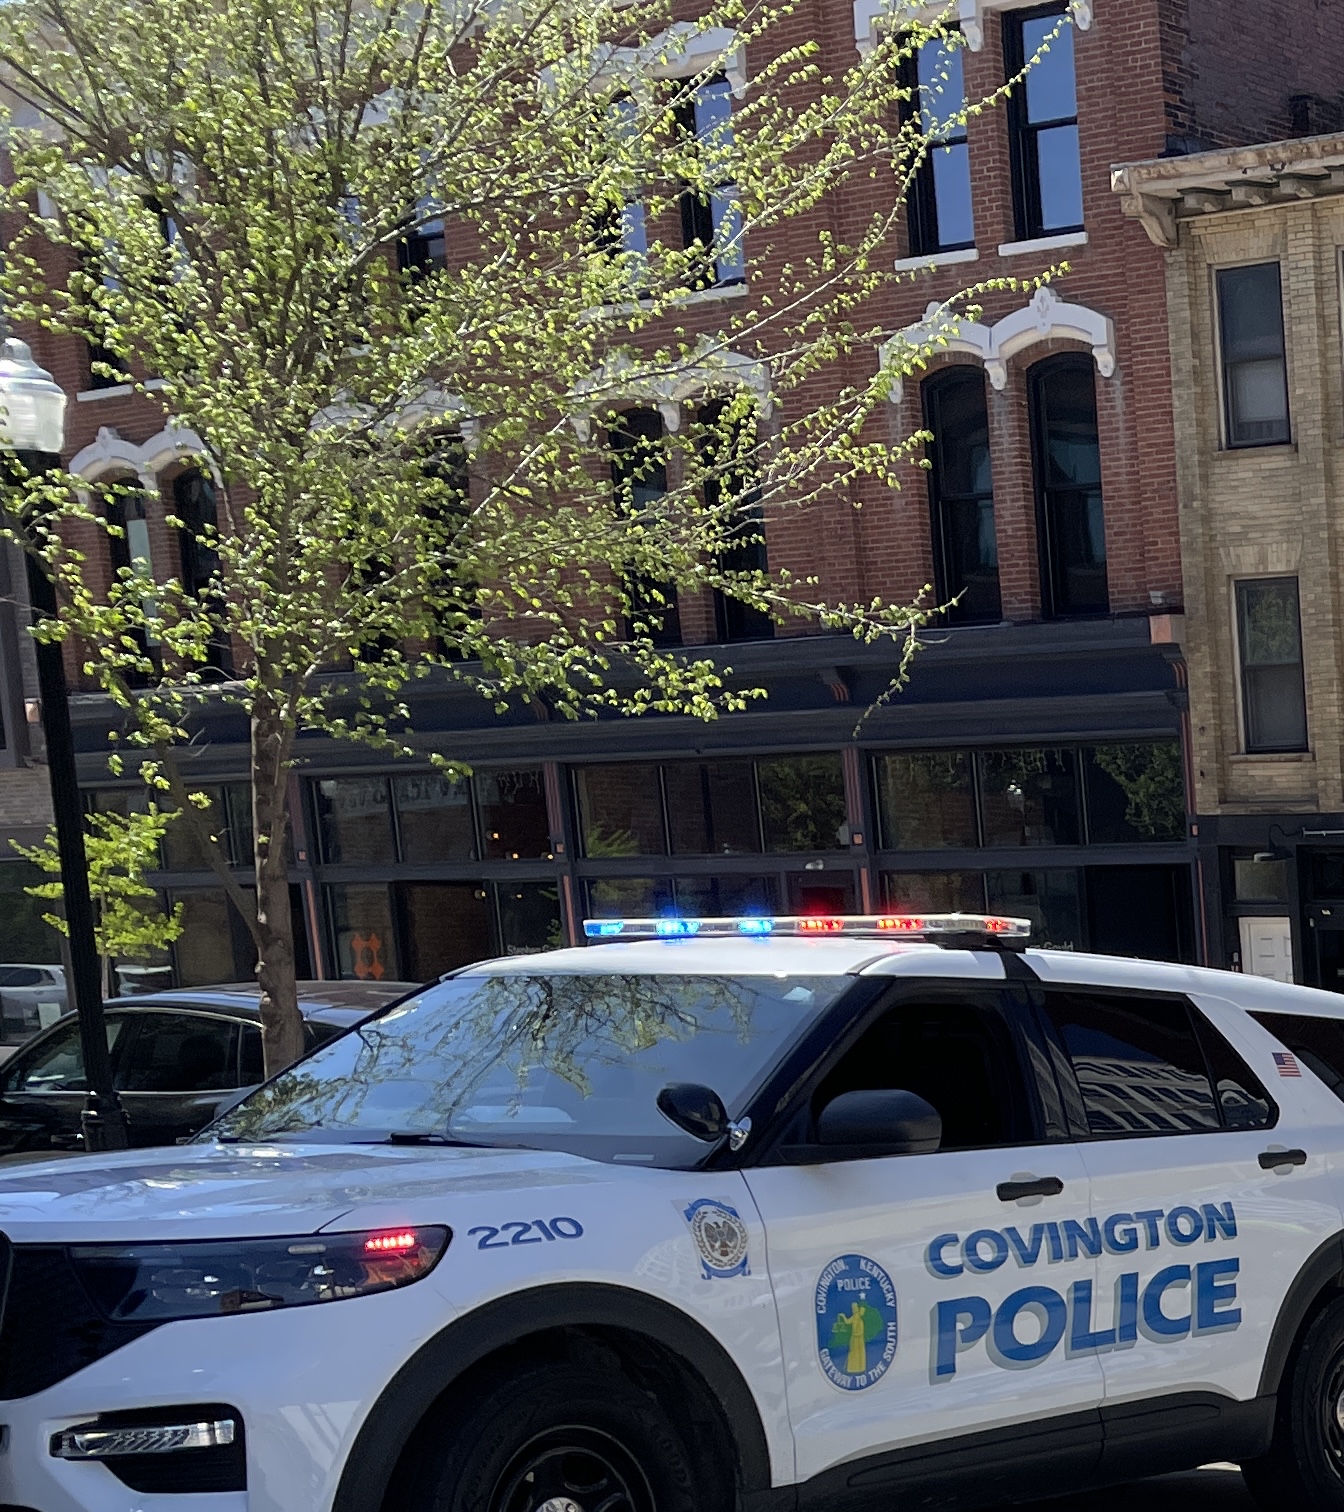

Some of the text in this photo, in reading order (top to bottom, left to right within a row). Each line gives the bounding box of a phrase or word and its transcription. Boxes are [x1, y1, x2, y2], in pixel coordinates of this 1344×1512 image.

[467, 1216, 584, 1250] 2210
[924, 1201, 1239, 1279] COVINGTON
[837, 1277, 872, 1291] POLICE
[859, 1258, 896, 1308] KENTUCKY
[929, 1257, 1242, 1386] POLICE
[820, 1322, 897, 1388] GATEWAY TO THE SOUTH
